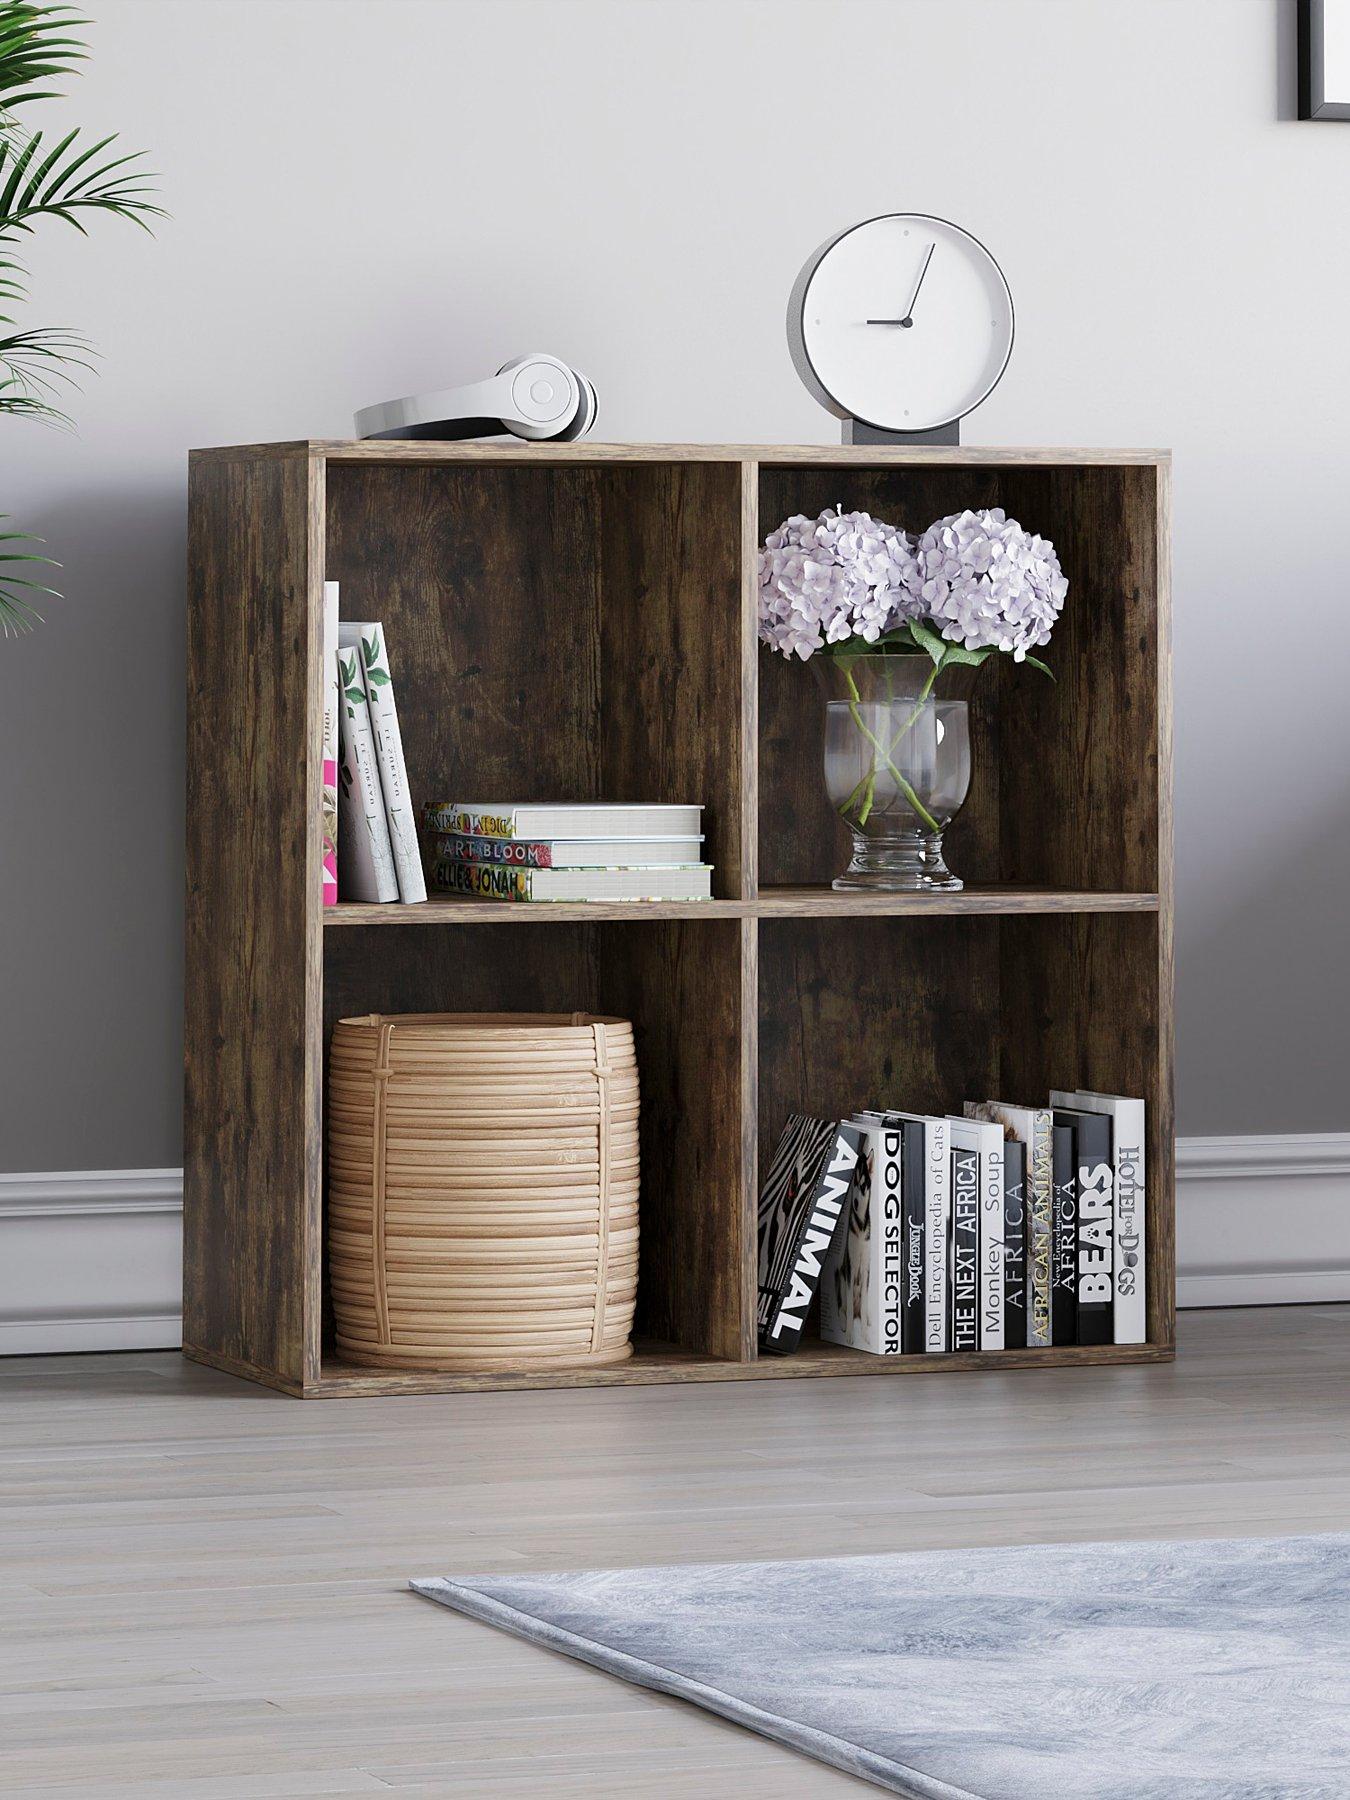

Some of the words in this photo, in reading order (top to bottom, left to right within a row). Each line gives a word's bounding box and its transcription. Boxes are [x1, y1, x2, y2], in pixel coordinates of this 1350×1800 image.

[443, 840, 475, 857] ART
[483, 843, 538, 862] BLOOM
[489, 817, 507, 834] DIG
[476, 868, 518, 893] JONAH
[884, 1132, 901, 1219] DOG
[930, 1166, 943, 1185] of
[931, 1126, 943, 1162] Cats
[1033, 1111, 1051, 1222] ANIMALS
[956, 1157, 976, 1233] AFRICA
[985, 1152, 1004, 1212] Soup
[1053, 1183, 1061, 1195] of
[1118, 1147, 1140, 1221] HOTEL
[771, 1135, 860, 1340] ANIMAL
[929, 1193, 945, 1303] Encyclopedia
[1005, 1183, 1023, 1308] AFRICA
[1053, 1197, 1063, 1268] Encyclopedia
[1061, 1177, 1076, 1293] AFRICA
[1079, 1163, 1114, 1303] BEARS
[884, 1225, 901, 1354] SELECTOR
[956, 1245, 975, 1299] NEXT
[984, 1237, 1004, 1333] Monkey
[1032, 1233, 1050, 1340] AFRICAN
[1053, 1270, 1061, 1288] New
[929, 1313, 942, 1347] Dell
[956, 1307, 975, 1348] THE
